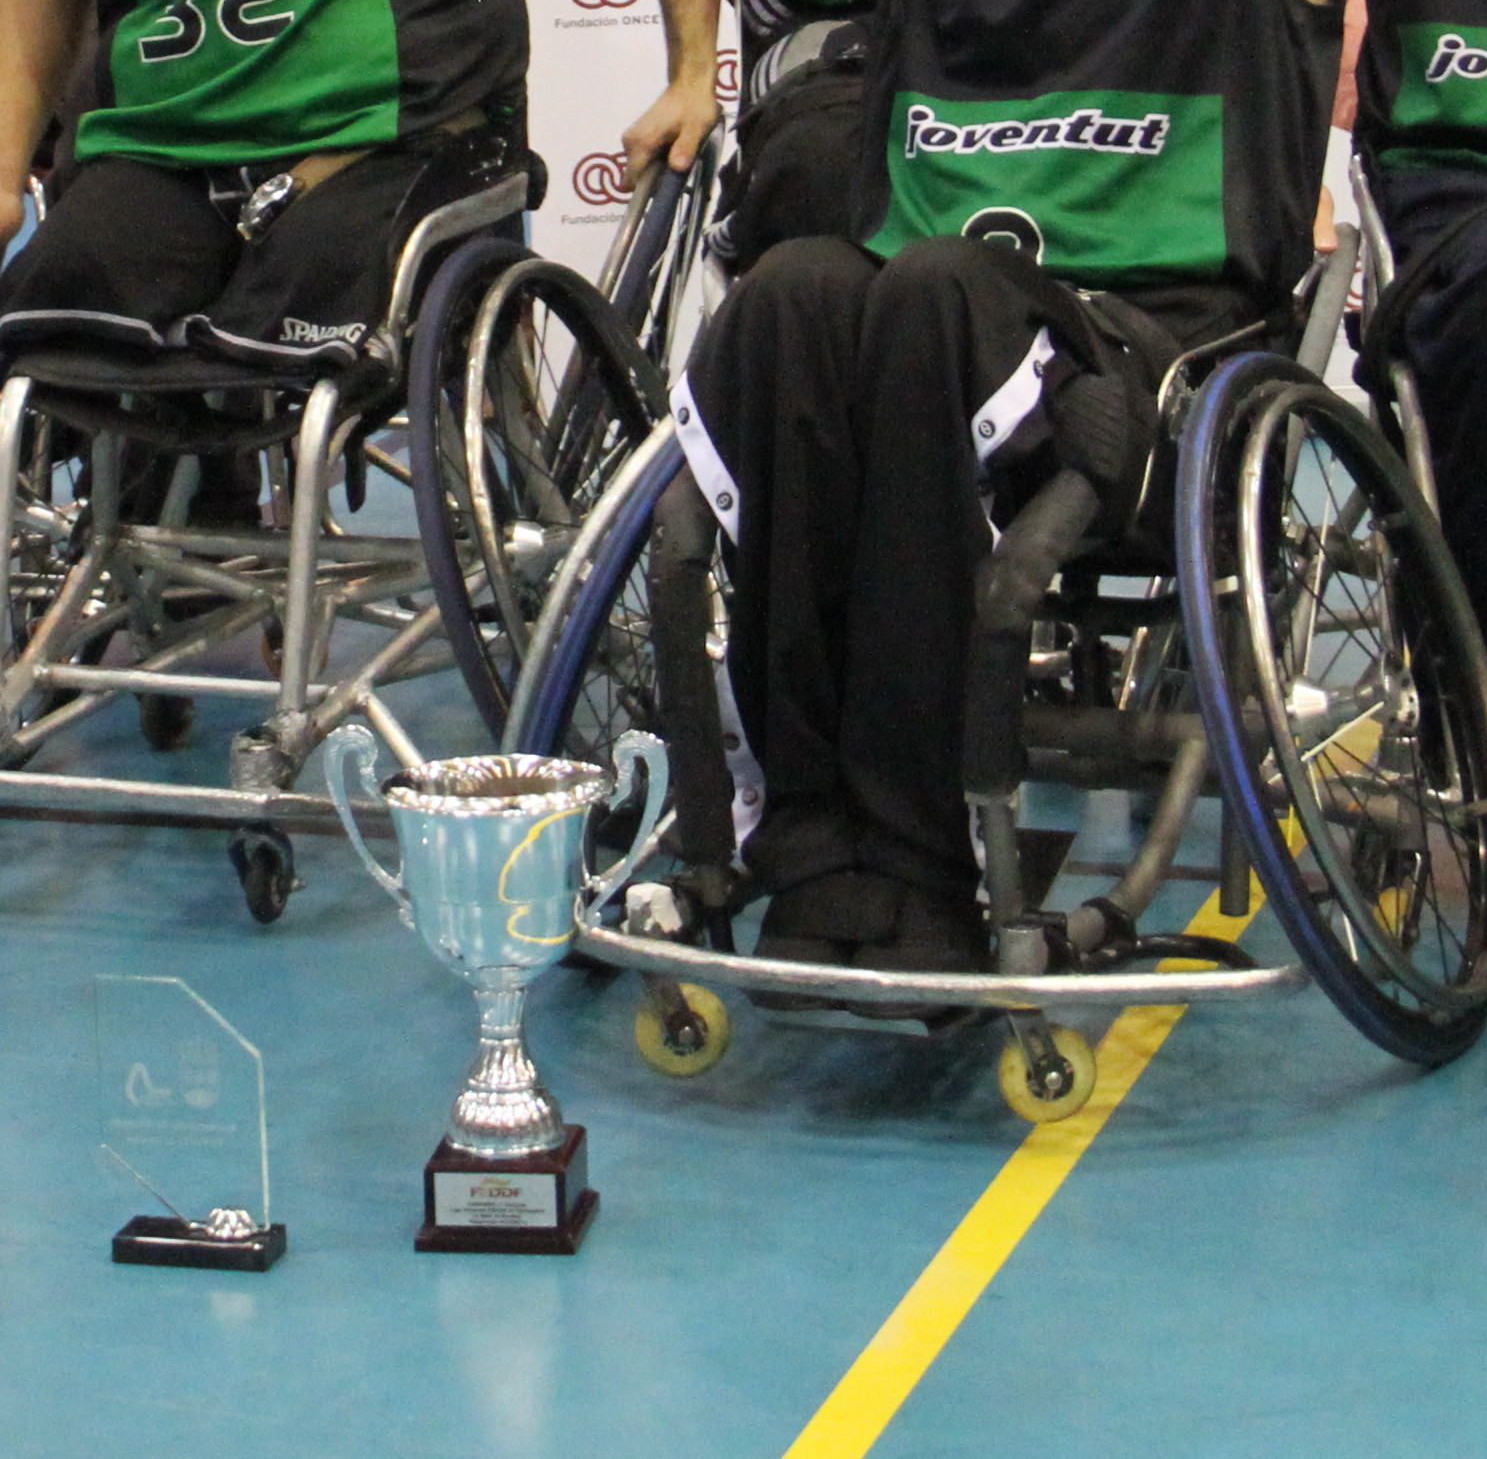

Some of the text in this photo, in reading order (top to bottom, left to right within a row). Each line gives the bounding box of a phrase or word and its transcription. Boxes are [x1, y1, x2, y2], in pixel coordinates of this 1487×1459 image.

[554, 14, 660, 29] Fundación ONCE
[905, 104, 1171, 159] joventut
